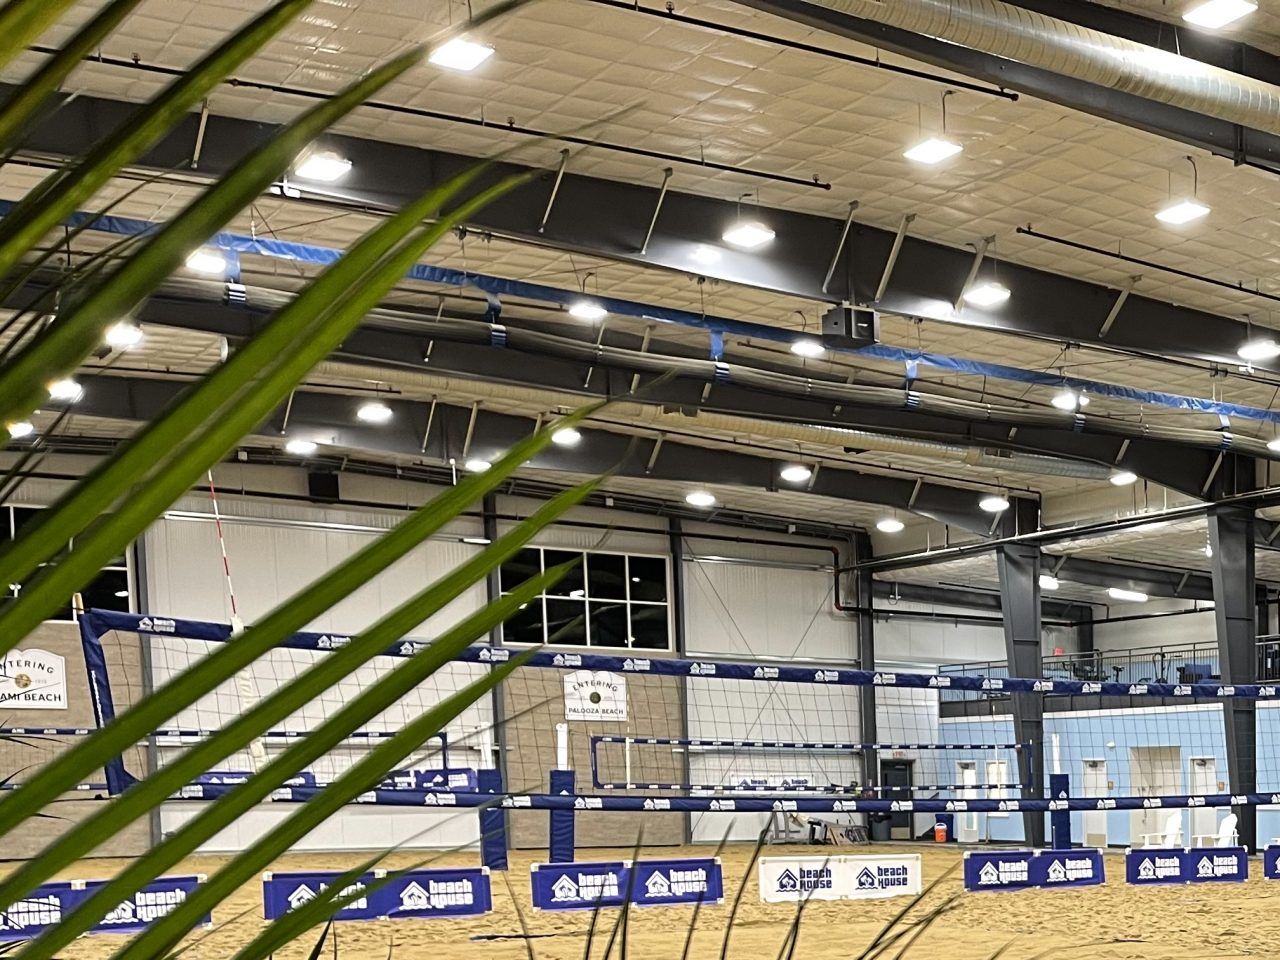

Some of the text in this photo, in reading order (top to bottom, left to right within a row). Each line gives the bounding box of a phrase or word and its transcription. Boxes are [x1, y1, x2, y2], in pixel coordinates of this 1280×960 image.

[572, 680, 618, 692] ENTERING
[24, 693, 61, 701] BEACH
[568, 707, 600, 715] PALOOZA
[669, 867, 707, 882] beach
[799, 866, 832, 879] beach
[877, 865, 908, 876] beach
[578, 871, 617, 886] beach
[429, 878, 473, 894] beach
